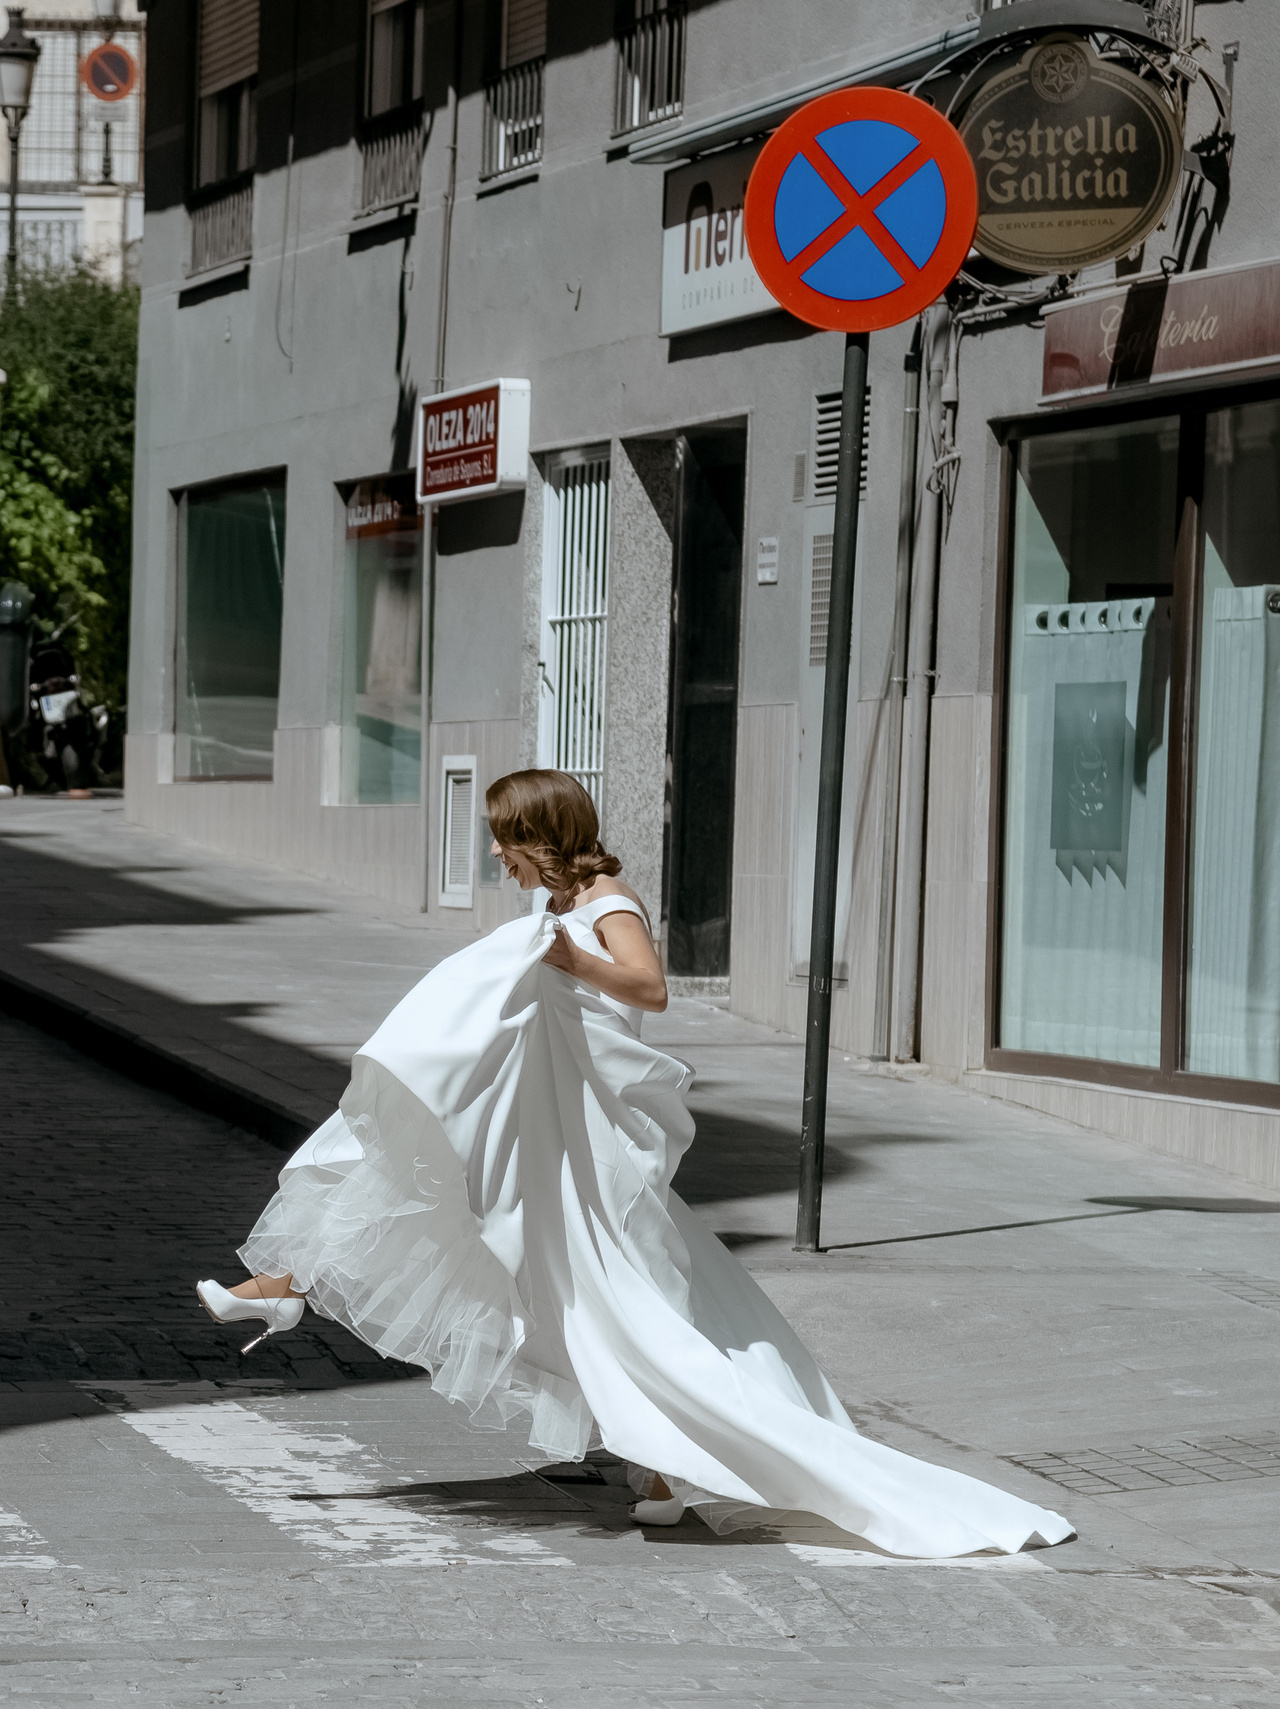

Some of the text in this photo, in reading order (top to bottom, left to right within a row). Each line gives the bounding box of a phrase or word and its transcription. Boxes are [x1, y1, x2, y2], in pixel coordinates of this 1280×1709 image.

[977, 114, 1138, 161] Estrella
[985, 157, 1129, 204] Galicia
[997, 217, 1116, 232] CERVEZA ESPECIAL
[426, 400, 495, 454] OLEZA 2014
